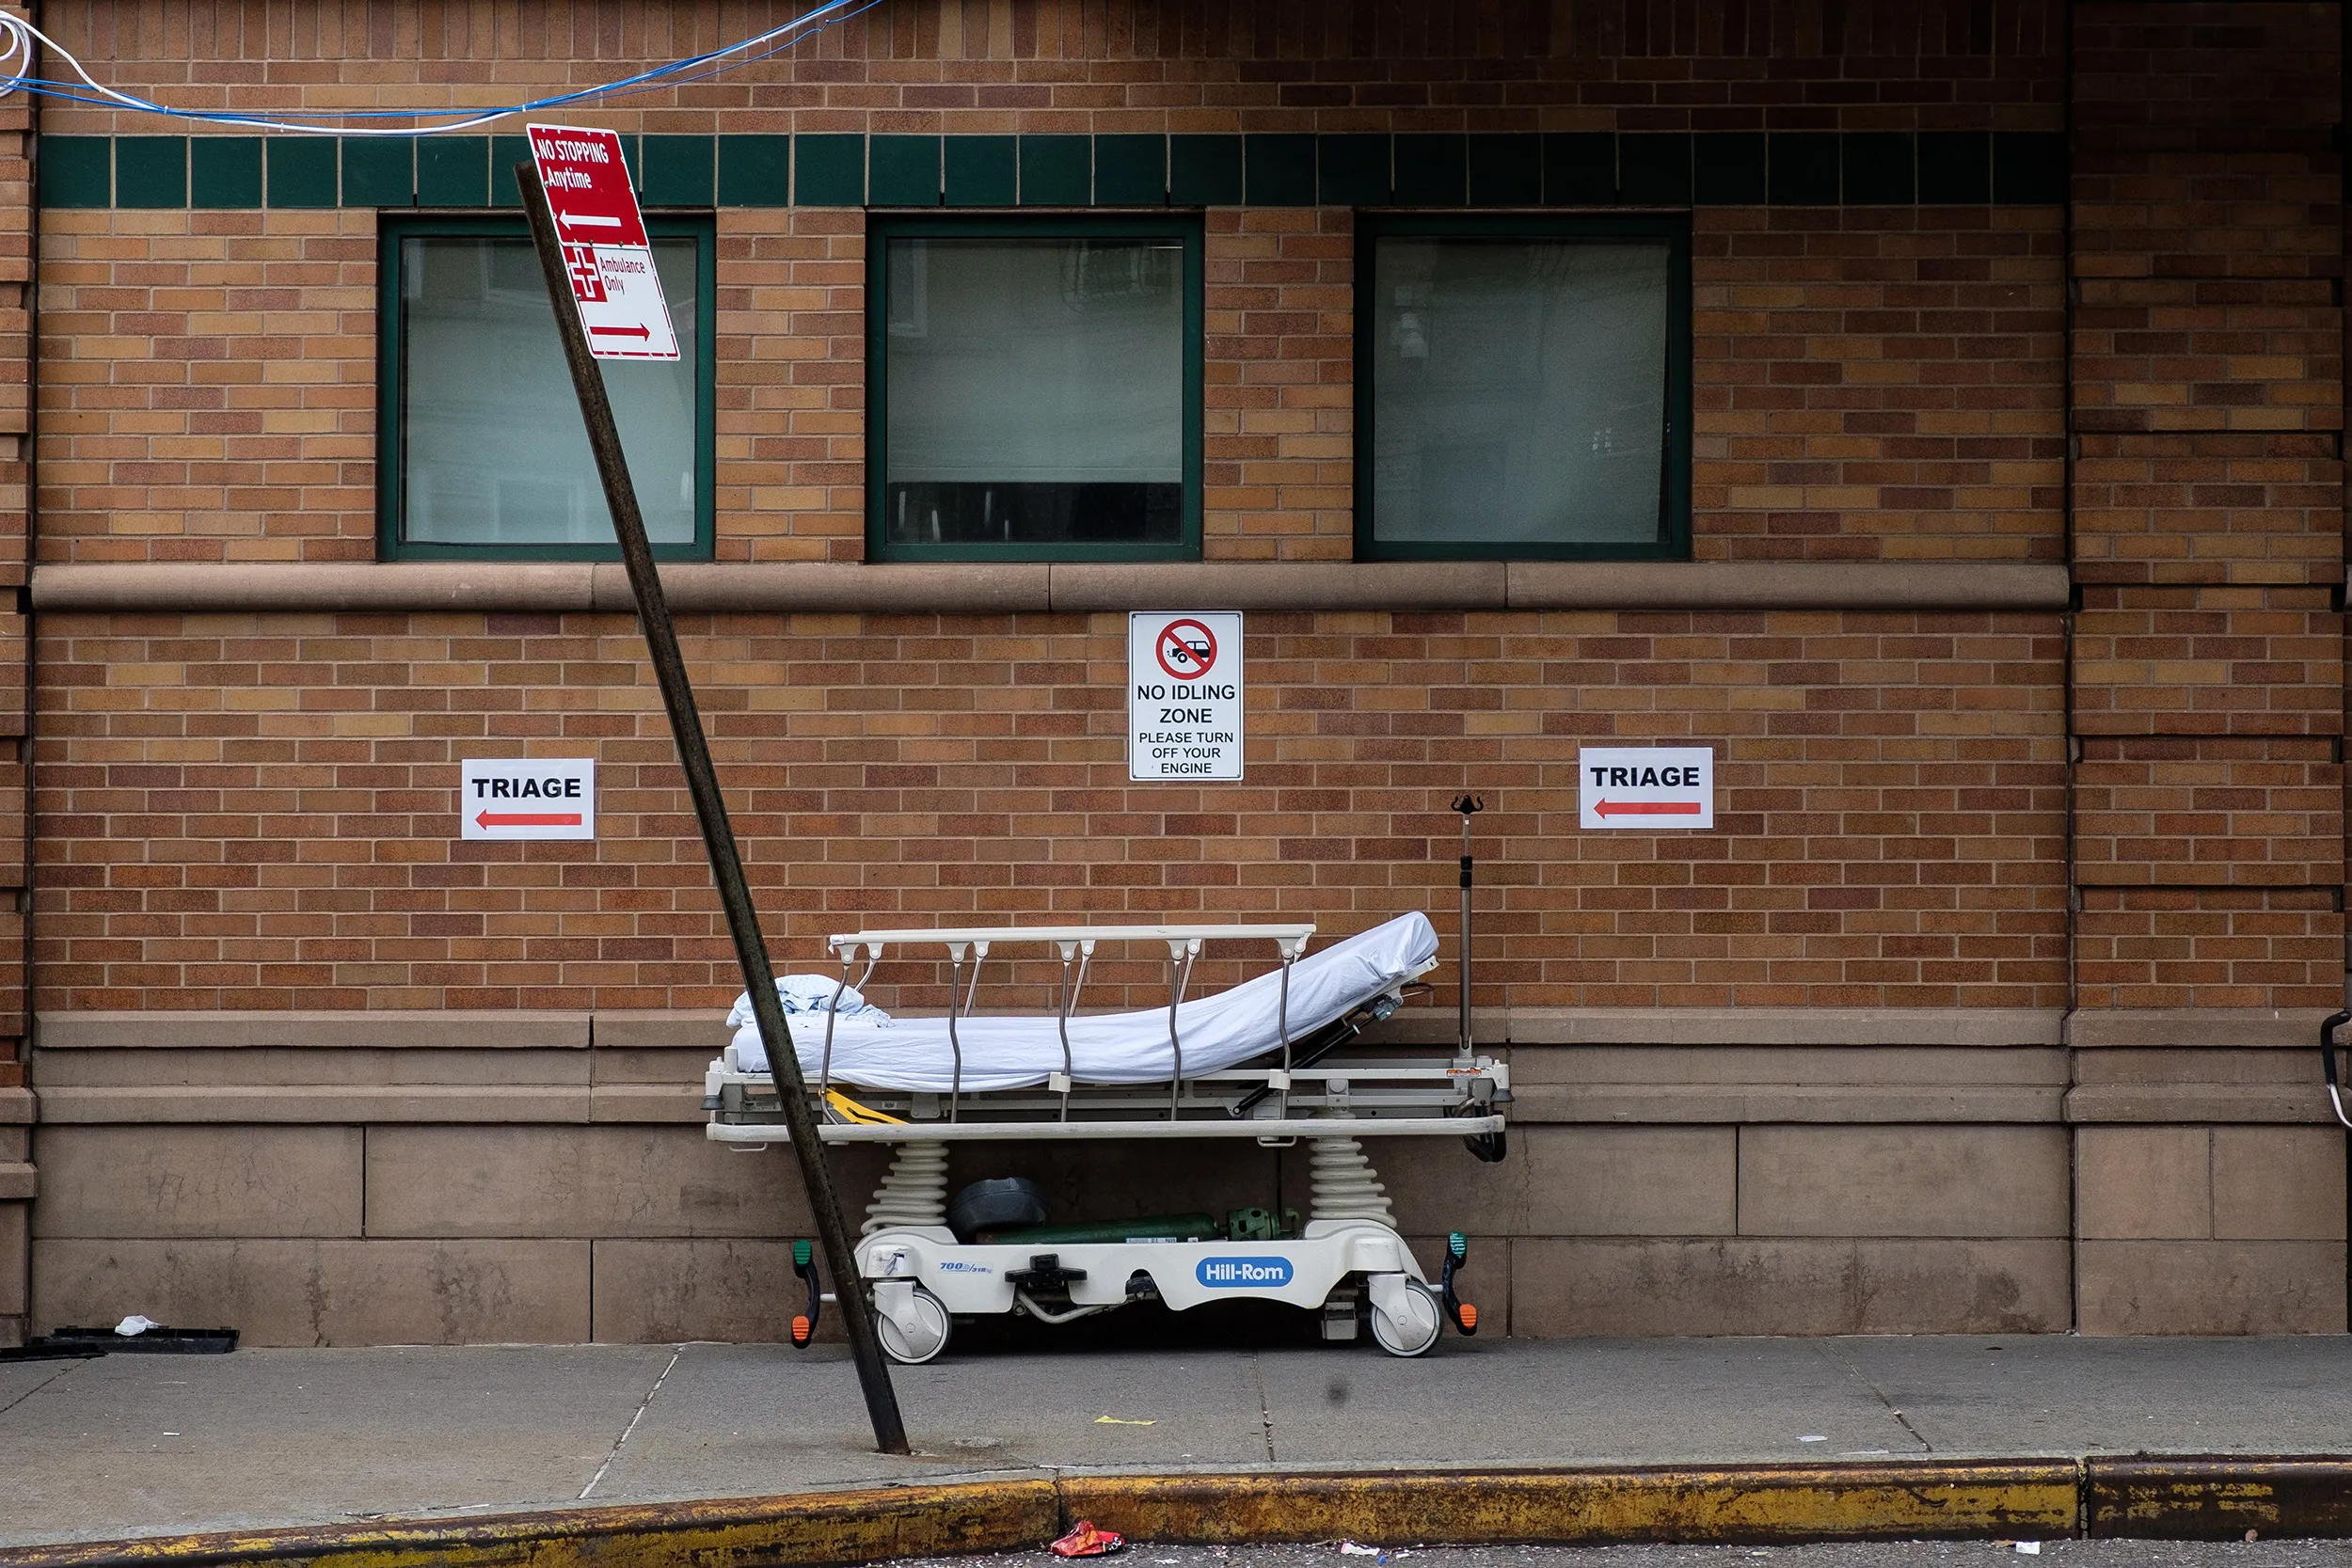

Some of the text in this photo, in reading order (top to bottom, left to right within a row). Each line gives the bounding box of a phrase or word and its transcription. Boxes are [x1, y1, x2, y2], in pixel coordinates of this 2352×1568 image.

[537, 138, 609, 164] NO STOPPING
[548, 166, 592, 192] Anytime
[601, 257, 645, 275] Ambulance
[605, 277, 626, 295] Only
[1137, 685, 1235, 700] NO IDLING
[1159, 708, 1213, 723] ZONE
[1139, 733, 1233, 743] PLEASE TURN
[1152, 748, 1221, 758] OFF YOUR
[1161, 763, 1213, 774] ENGINE
[1590, 767, 1700, 787] TRIAGE
[471, 778, 581, 799] TRIAGE
[1206, 1263, 1284, 1280] Hill-Rom
